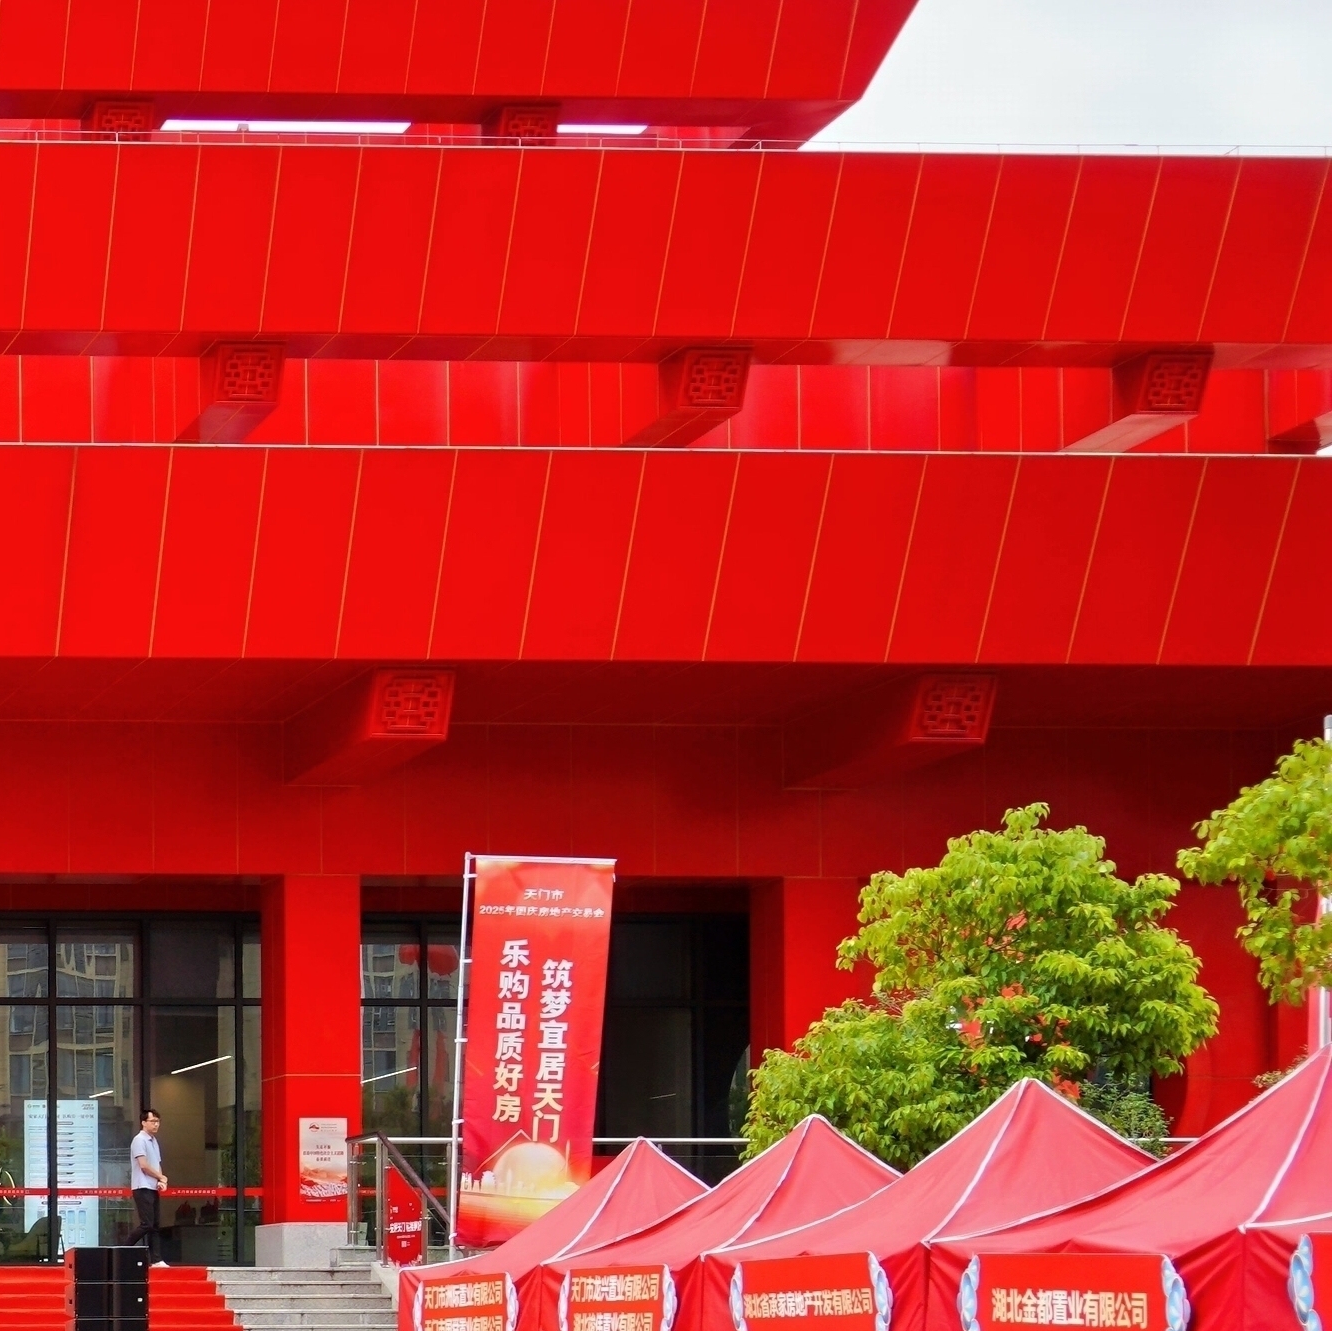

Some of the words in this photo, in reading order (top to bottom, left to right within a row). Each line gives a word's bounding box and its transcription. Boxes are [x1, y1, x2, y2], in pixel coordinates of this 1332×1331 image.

[479, 904, 605, 919] 2025年国庆房地产交易会
[523, 888, 565, 901] 天门市
[492, 938, 531, 1124] 乐购品质好房
[532, 958, 574, 1144] 筑梦宜居天门
[991, 1288, 1148, 1330] 湖北金都置业有限公司
